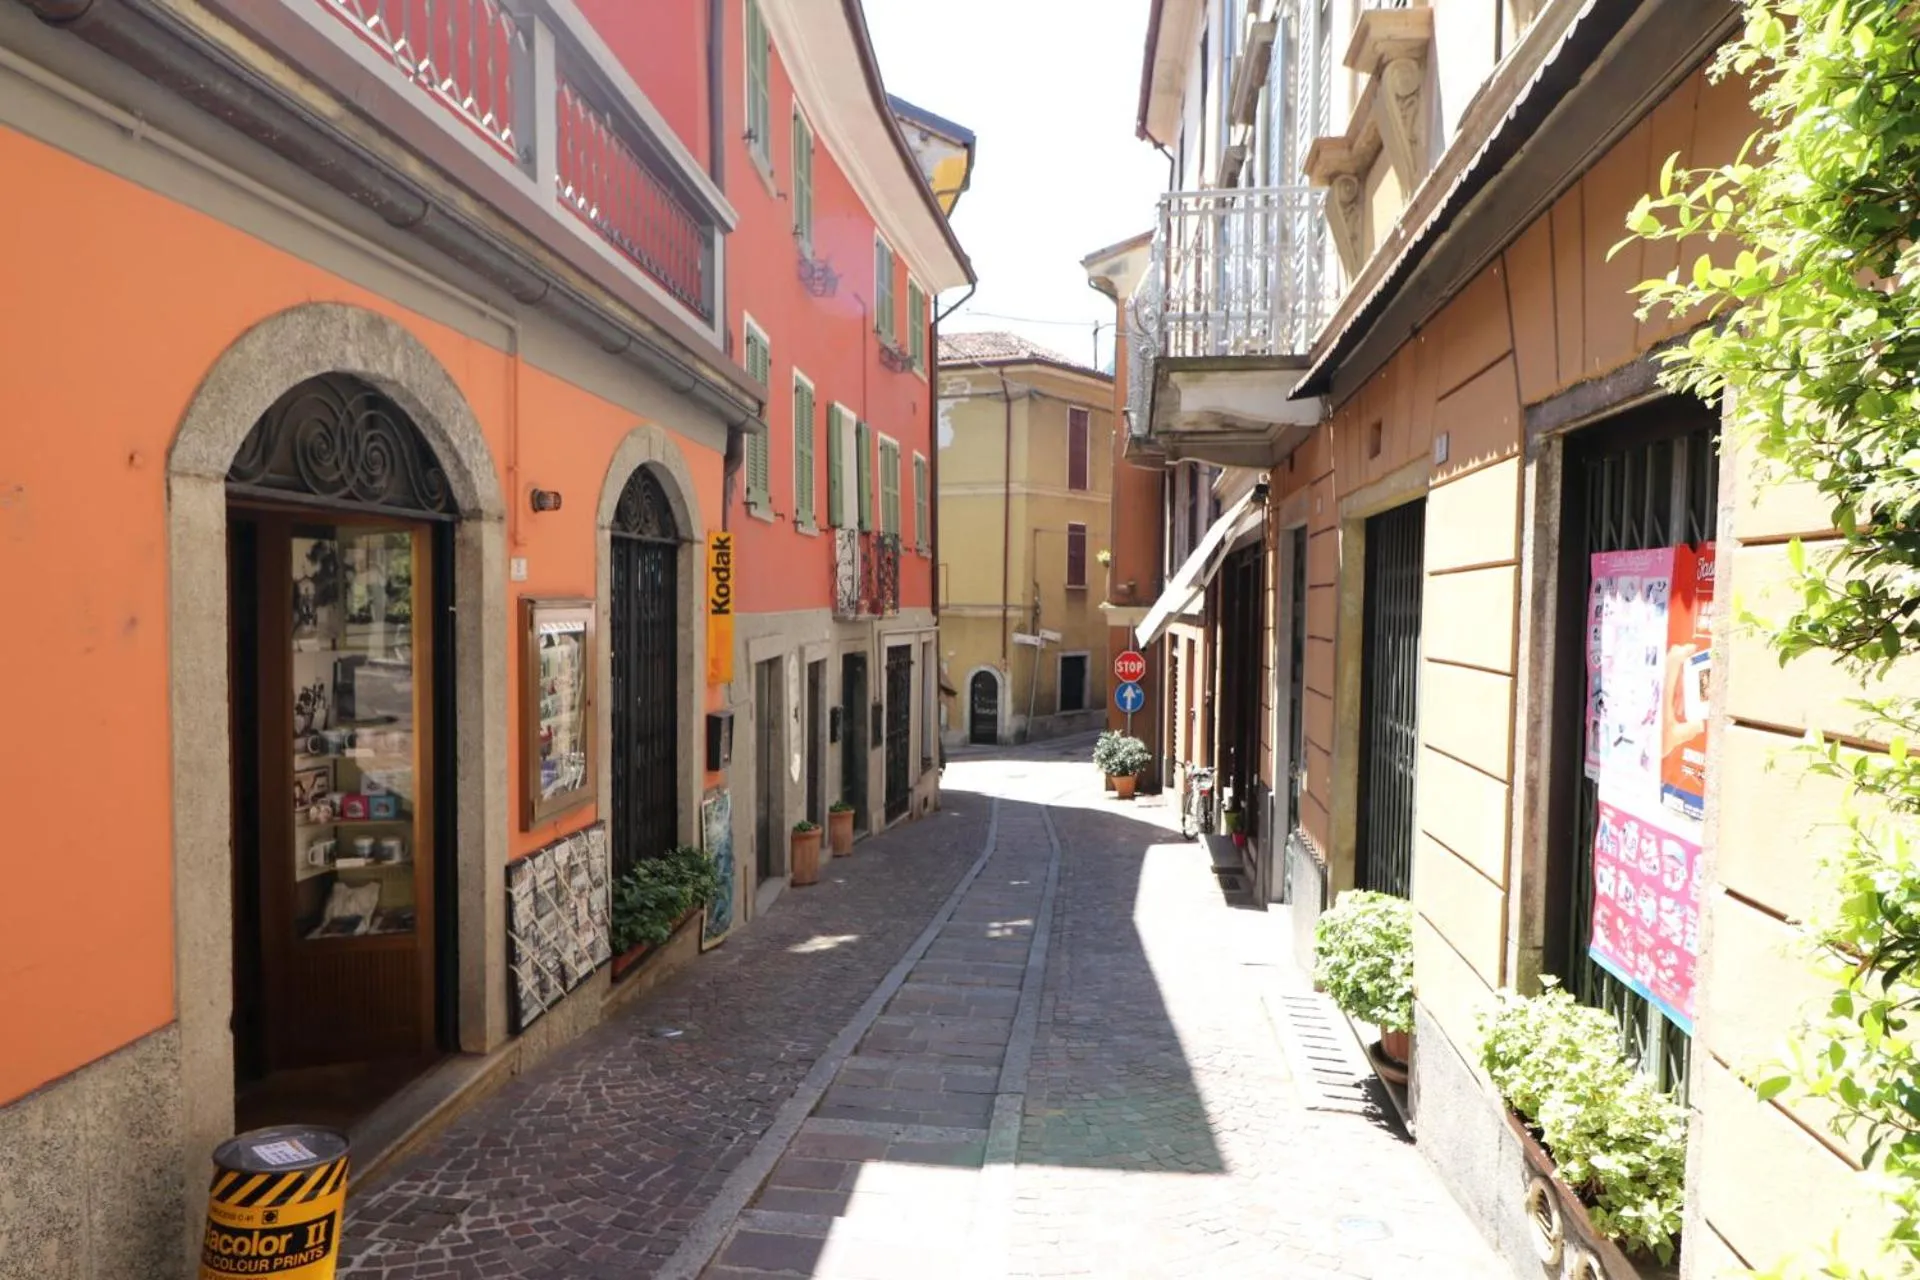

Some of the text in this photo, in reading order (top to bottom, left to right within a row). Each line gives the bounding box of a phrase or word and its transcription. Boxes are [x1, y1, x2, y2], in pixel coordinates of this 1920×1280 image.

[711, 536, 731, 615] Kodak
[1116, 661, 1143, 674] STOP
[213, 1254, 269, 1273] COLOUR
[272, 1246, 324, 1270] PRINTS
